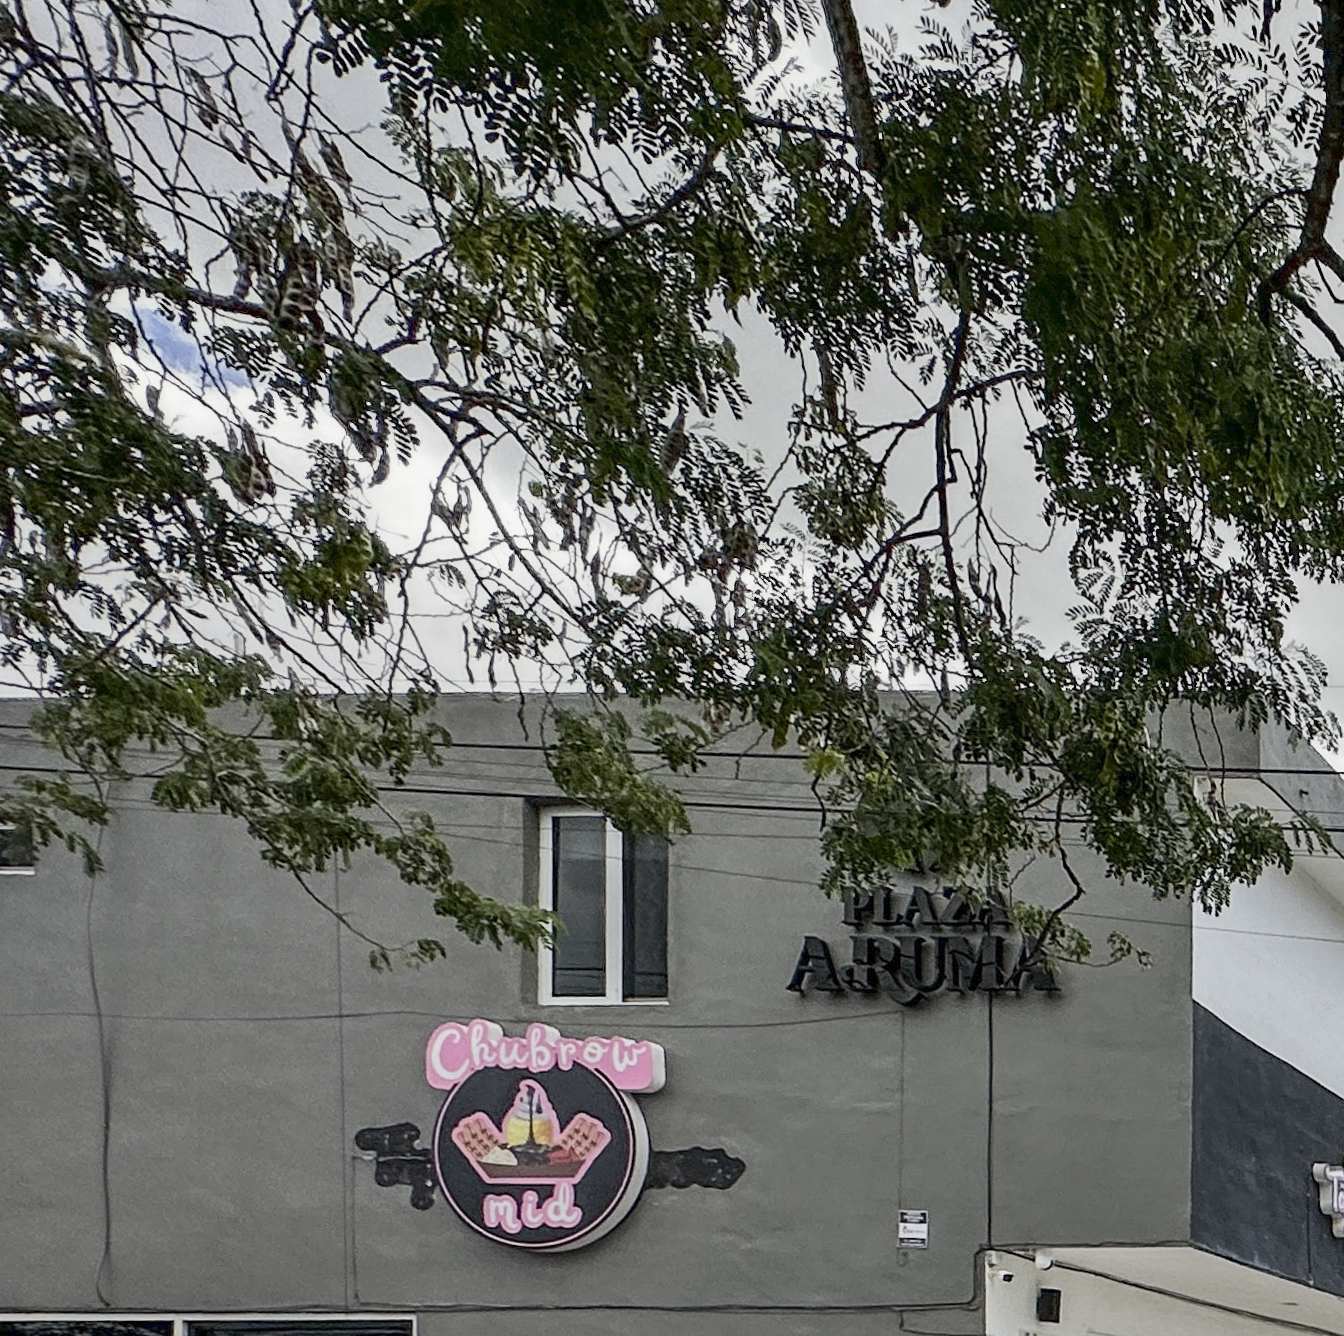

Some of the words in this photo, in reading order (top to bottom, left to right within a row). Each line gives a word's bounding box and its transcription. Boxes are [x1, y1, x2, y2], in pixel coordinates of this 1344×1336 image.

[842, 885, 1013, 927] PLAZA
[786, 935, 1061, 1006] ARUMA
[429, 1021, 647, 1082] Chubrow
[486, 1184, 581, 1232] mid
